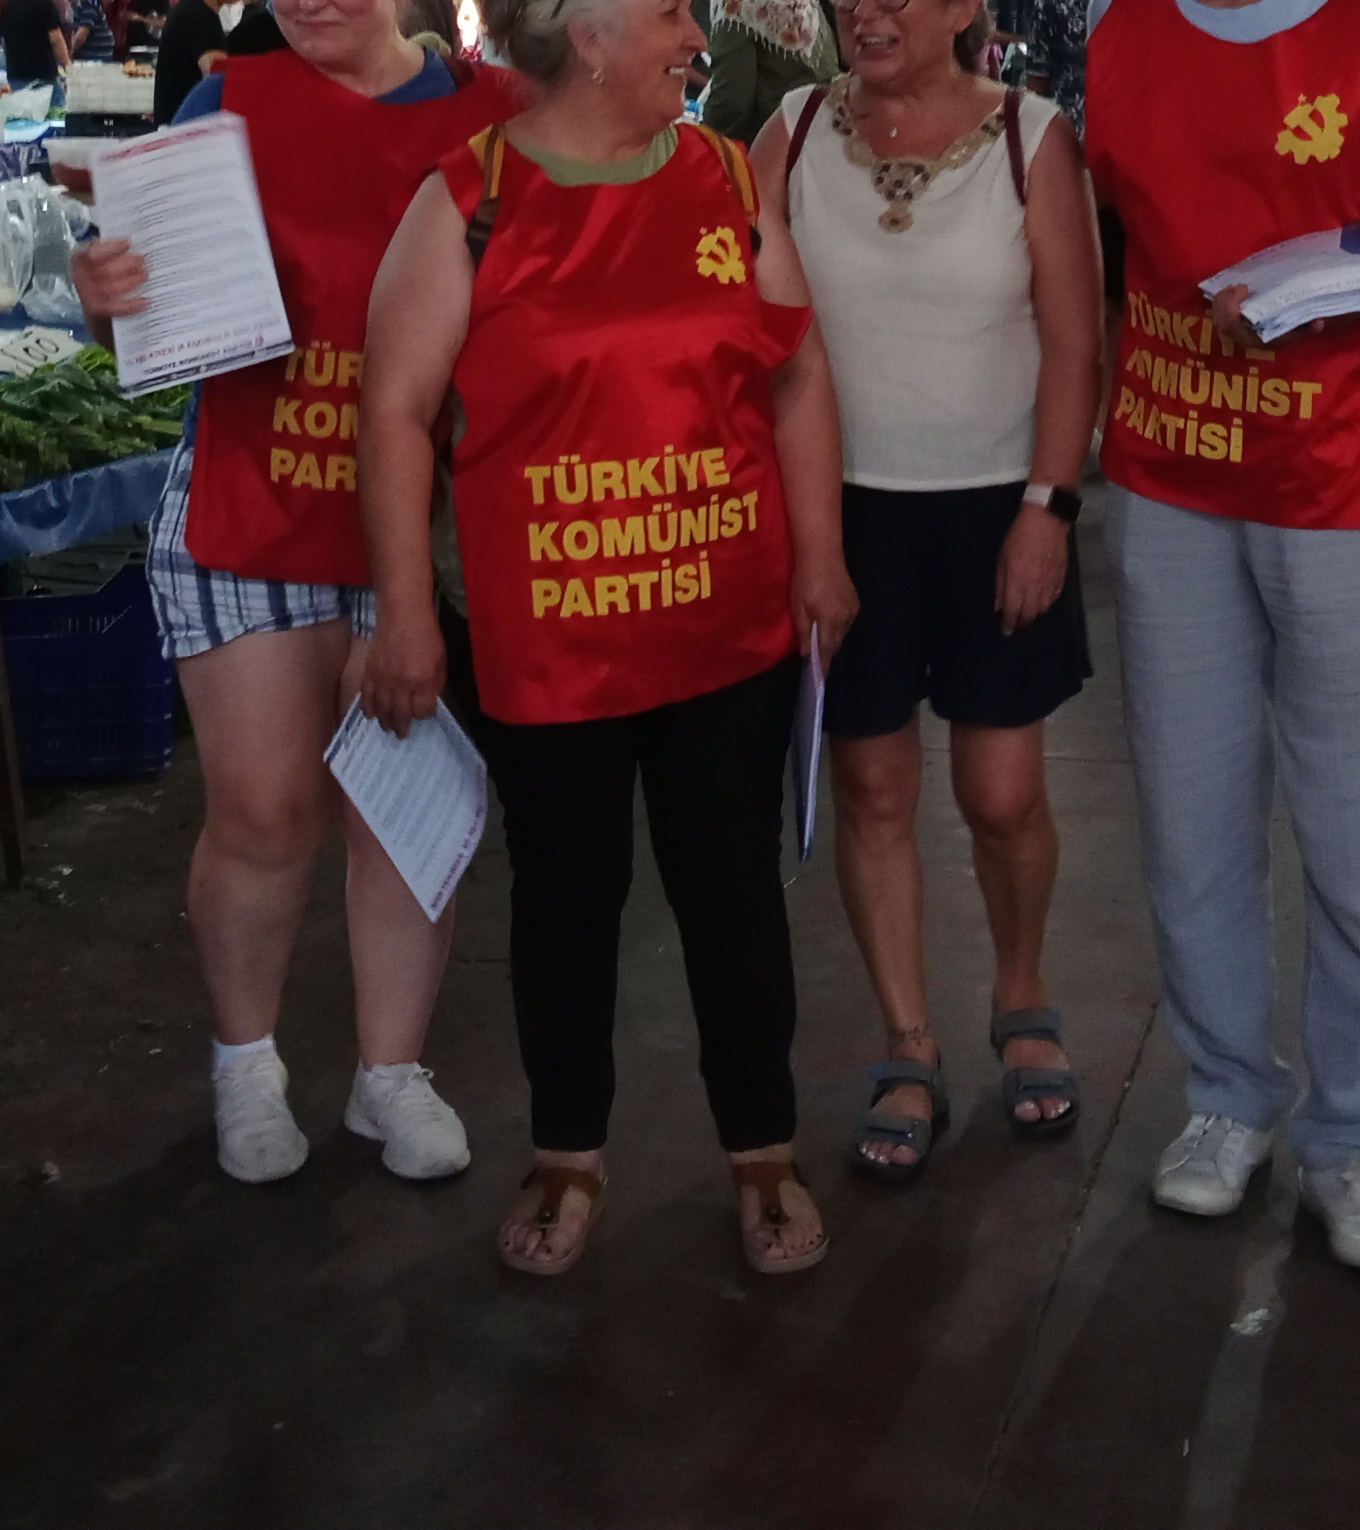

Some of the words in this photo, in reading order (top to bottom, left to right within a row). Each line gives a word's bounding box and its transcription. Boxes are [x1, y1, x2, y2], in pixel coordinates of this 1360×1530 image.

[1114, 384, 1243, 463] PARTİSİ
[524, 444, 730, 505] TÜRKİYE
[528, 490, 758, 562] KOMÜNİST
[531, 550, 712, 618] PARTİSİ
